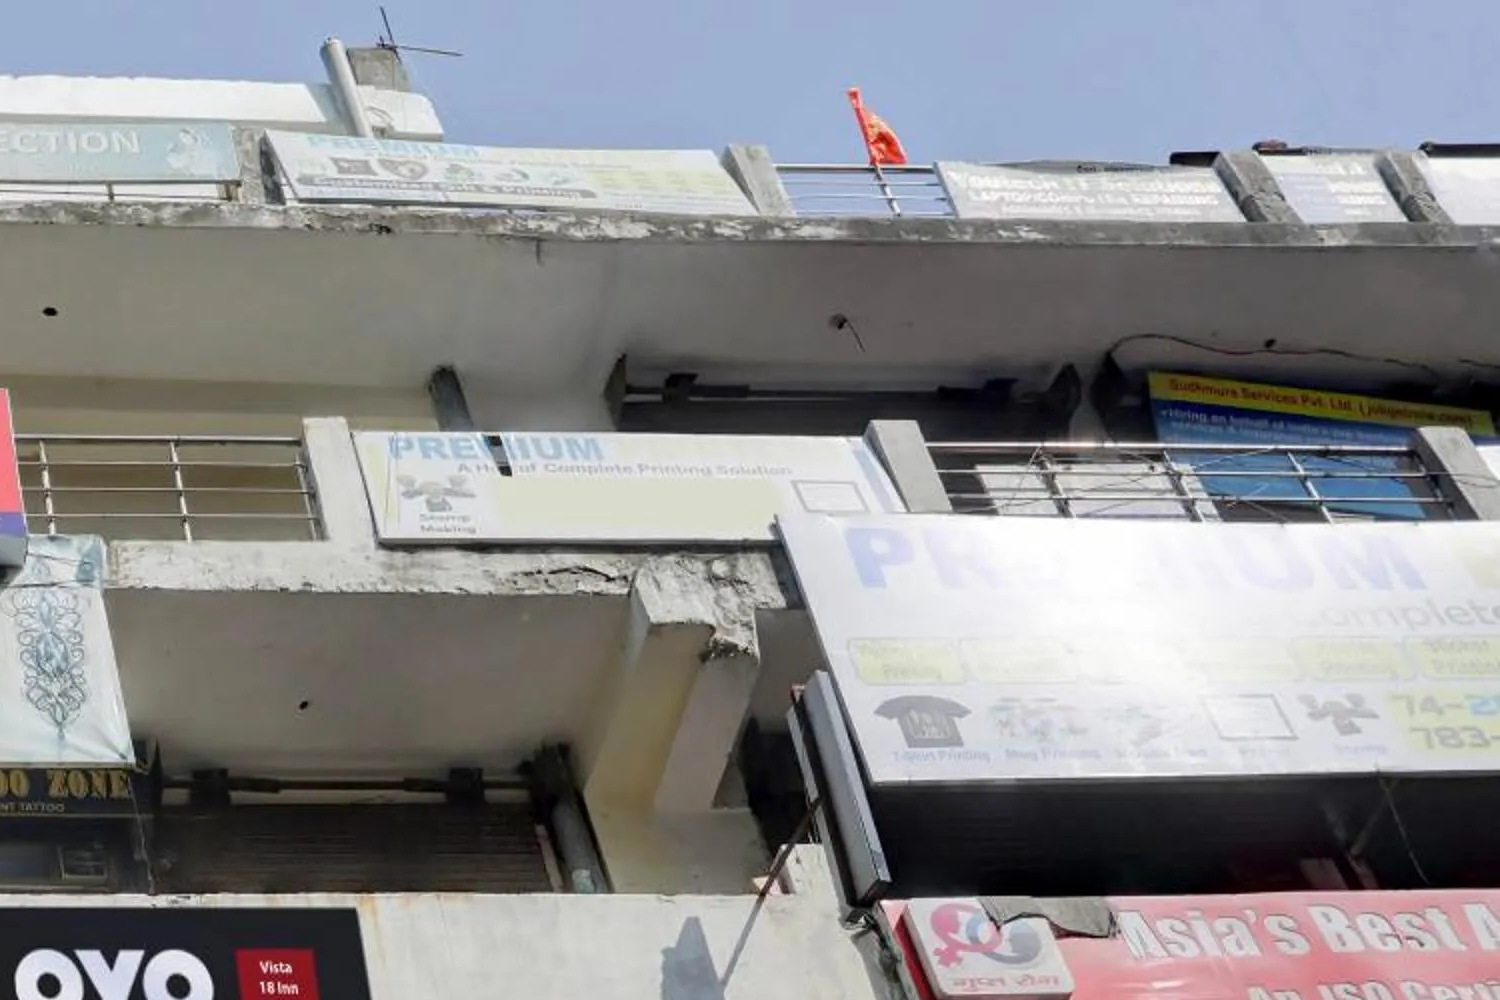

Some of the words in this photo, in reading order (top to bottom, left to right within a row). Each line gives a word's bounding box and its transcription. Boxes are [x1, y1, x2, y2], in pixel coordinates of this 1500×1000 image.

[543, 463, 634, 478] Complete
[636, 464, 713, 479] Printing
[45, 767, 130, 800] ZONE
[1117, 908, 1311, 960] Asia's
[1307, 902, 1469, 953] Best
[258, 960, 293, 976] Vista
[258, 980, 276, 996] 18
[277, 981, 300, 996] Inn
